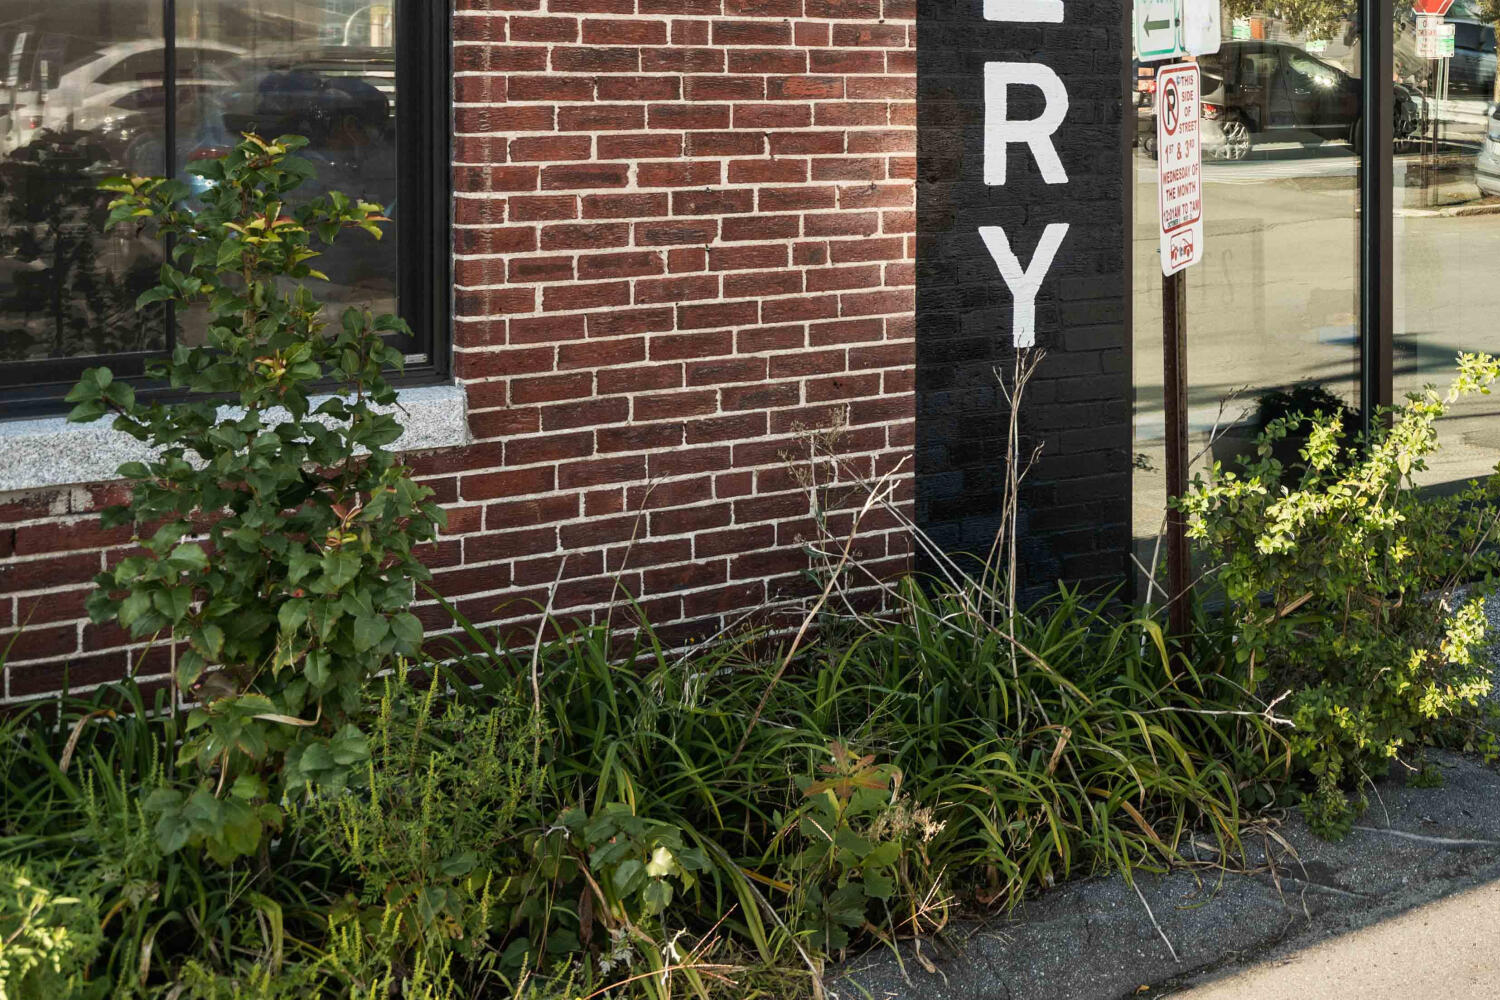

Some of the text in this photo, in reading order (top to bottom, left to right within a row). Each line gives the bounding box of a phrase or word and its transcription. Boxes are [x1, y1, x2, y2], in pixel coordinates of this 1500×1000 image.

[1181, 75, 1194, 86] THIS
[1181, 90, 1194, 102] SIDE
[1184, 105, 1192, 117] OF
[1179, 120, 1197, 134] STREET
[1176, 142, 1182, 160] &
[1163, 163, 1199, 185] WEDNESDAY OF
[1166, 181, 1196, 201] THE MONTH
[1181, 202, 1189, 215] TO
